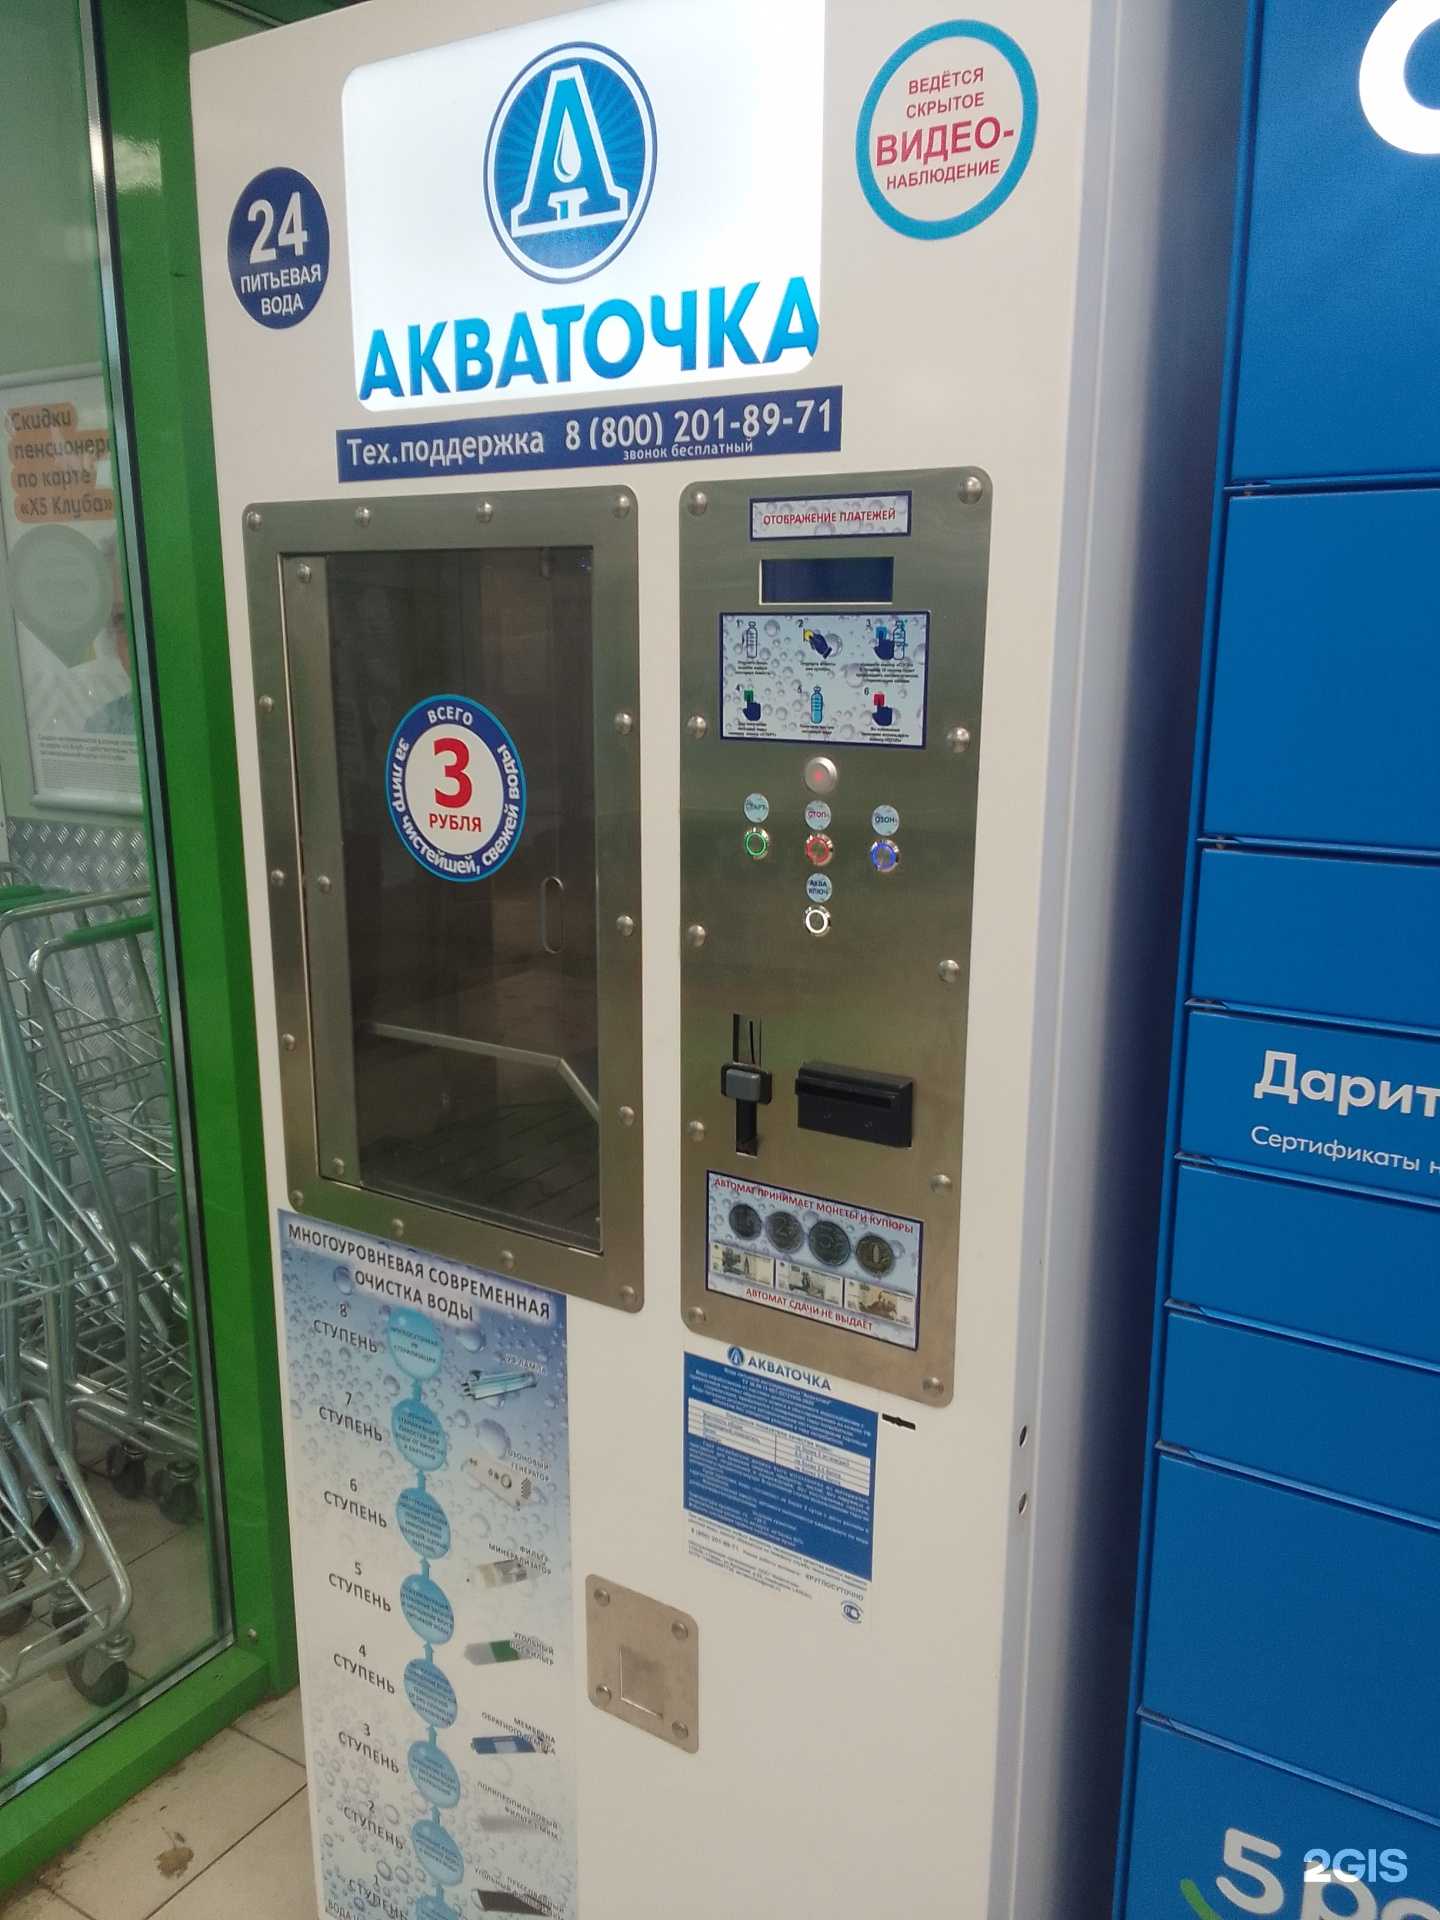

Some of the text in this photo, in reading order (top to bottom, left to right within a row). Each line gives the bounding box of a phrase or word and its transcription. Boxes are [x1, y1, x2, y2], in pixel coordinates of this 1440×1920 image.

[908, 66, 984, 95] ВЕДЁТСЯ
[906, 92, 984, 119] СКРЫТОЕ
[876, 116, 1014, 166] ВИДЕО-
[886, 158, 1000, 190] НАБЛЮДЕНИЕ
[247, 192, 309, 264] 24
[240, 264, 321, 294] ПИТЬЕВАЯ
[261, 293, 304, 316] ВОДА
[359, 275, 820, 401] АКВАТОЧКА
[11, 408, 72, 431] Скидки
[347, 398, 832, 470] Тех.поддержка 8 (800) 201-89-71
[622, 438, 754, 461] звонок бесплатный
[17, 468, 91, 490] по карте
[53, 494, 113, 518] Клуба»
[763, 508, 896, 526] ОТОБРАЖЕНИЕ ПЛАТЕЖЕЙ
[427, 706, 473, 726] ВСЕГО
[433, 737, 473, 808] 3
[391, 737, 521, 875] за литр чистейшей, свежей воды
[874, 816, 895, 824] ОЗОН
[428, 813, 482, 833] РУБЛЯ
[1251, 1126, 1420, 1172] Сертификаты
[714, 1177, 914, 1234] АВТОМАТ ПРИНИМАЕТ МОНЕТЫ И КУПЮРЫ
[288, 1223, 551, 1320] МНОГОУРОВНЕВАЯ СОВРЕМЕННАЯ
[339, 1303, 348, 1318] 8
[354, 1269, 473, 1321] ОЧИСТКА ВОДЫ
[746, 1287, 786, 1306] АВТОМАТ
[789, 1300, 819, 1316] СДАЧИ
[821, 1308, 833, 1319] НЕ
[313, 1318, 378, 1353] СТУПЕНЬ
[748, 1356, 832, 1391] АКВАТОЧКА
[345, 1391, 352, 1405] 7
[318, 1406, 383, 1442] СТУПЕНЬ
[349, 1478, 358, 1492] 6
[323, 1490, 388, 1528] СТУПЕНЬ
[355, 1562, 362, 1575] 5
[328, 1573, 392, 1612] СТУПЕНЬ
[358, 1645, 367, 1658] 4
[333, 1653, 396, 1695] СТУПЕНЬ
[363, 1724, 371, 1736] 3
[338, 1731, 401, 1774] СТУПЕНЬ
[367, 1800, 375, 1814] 2
[343, 1806, 404, 1850] СТУПЕНЬ
